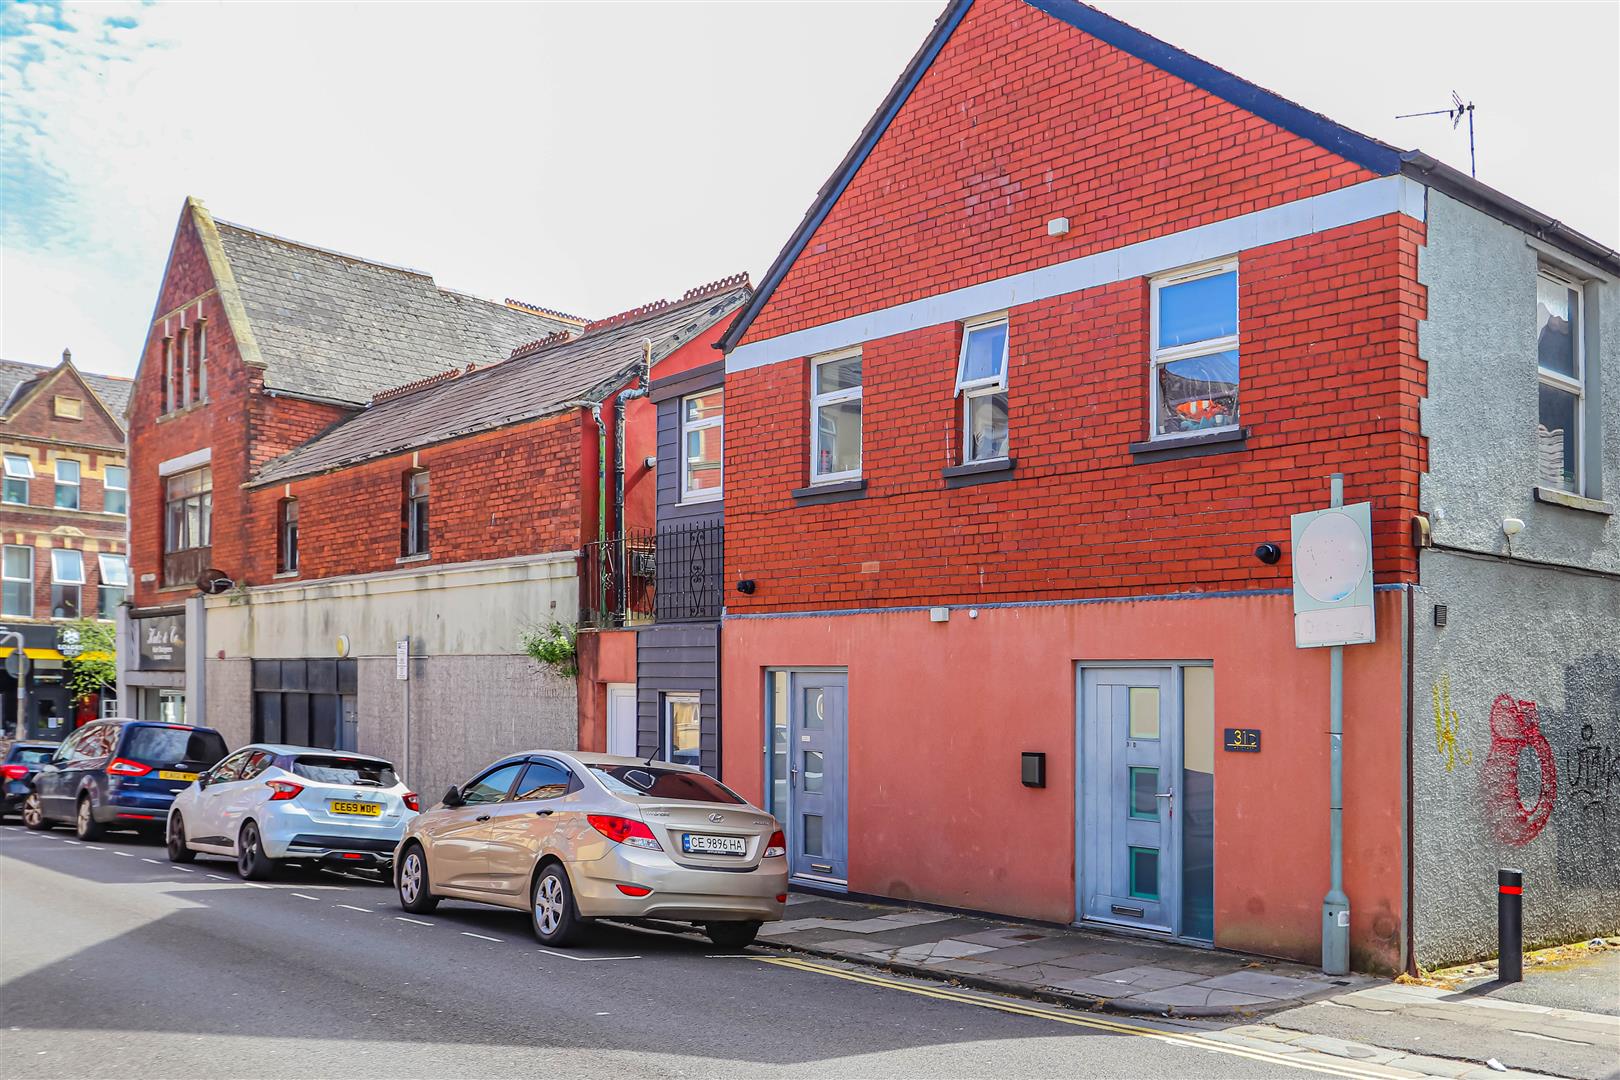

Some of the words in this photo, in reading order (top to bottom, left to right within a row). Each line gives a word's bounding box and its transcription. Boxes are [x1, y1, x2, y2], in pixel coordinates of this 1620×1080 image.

[334, 802, 358, 812] CE69
[691, 837, 705, 848] CE
[706, 838, 728, 849] 9896
[729, 839, 743, 850] HA
